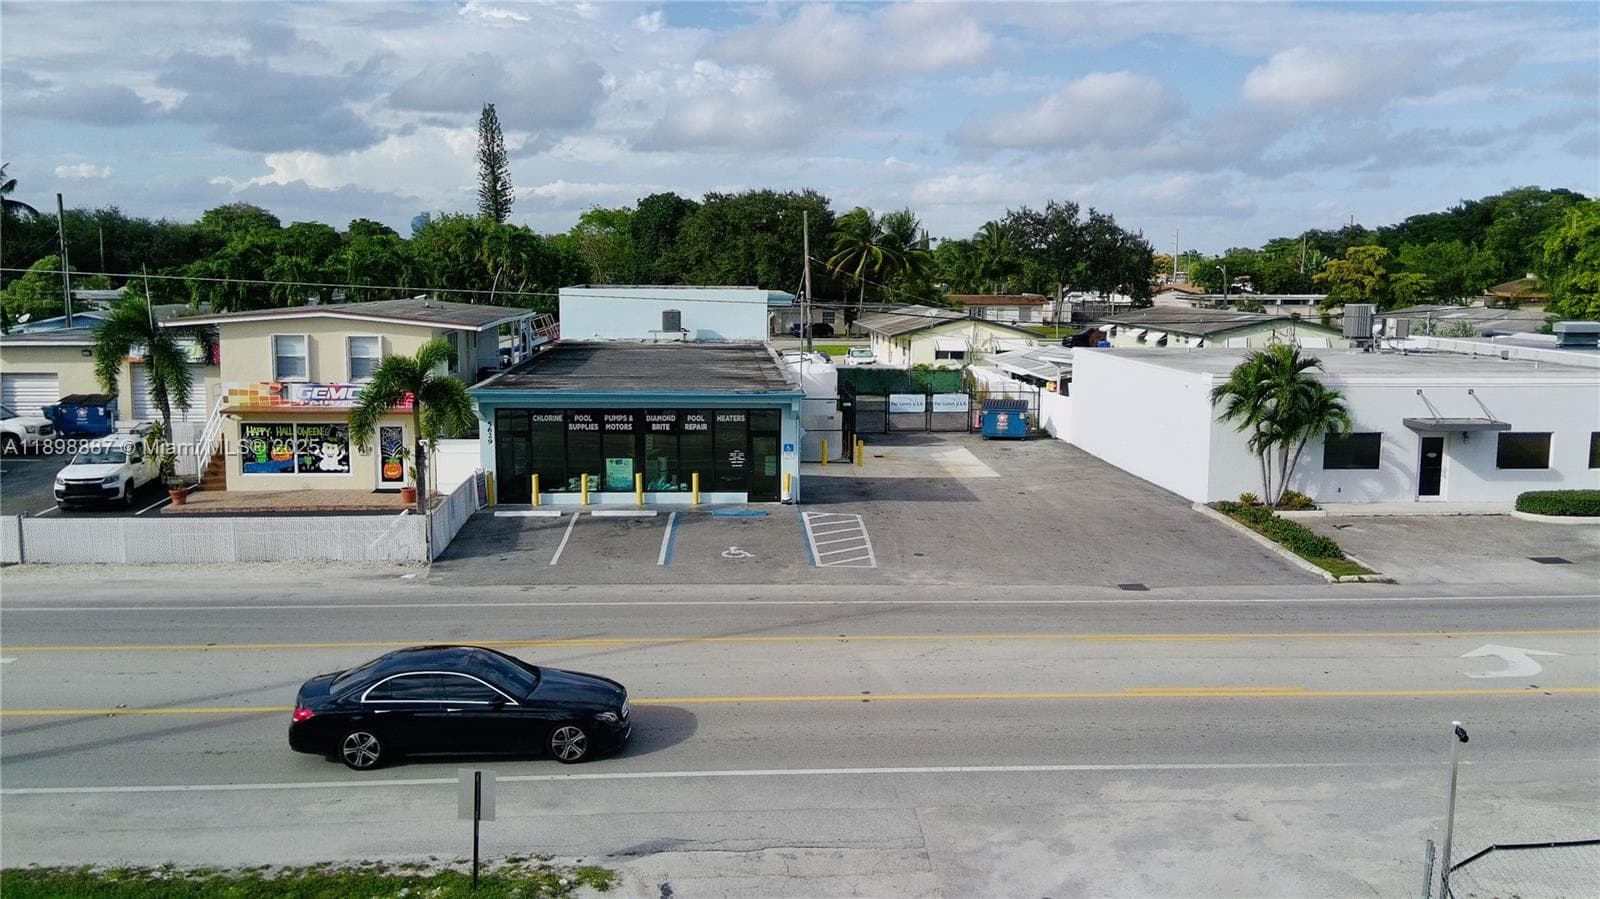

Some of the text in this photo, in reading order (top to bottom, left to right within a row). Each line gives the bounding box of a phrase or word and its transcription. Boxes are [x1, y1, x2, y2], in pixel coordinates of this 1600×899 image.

[532, 414, 563, 422] CHLORINE
[574, 414, 592, 422] POOL
[604, 414, 634, 422] PUMPS &
[645, 414, 676, 422] DIAMOND
[687, 414, 705, 422] POOL
[716, 414, 746, 422] HEATERS
[246, 425, 271, 437] HAPPY
[568, 423, 599, 431] SUPPLIES
[605, 423, 633, 431] MOTORS
[651, 423, 671, 431] BRITE
[684, 423, 708, 431] REPAIR
